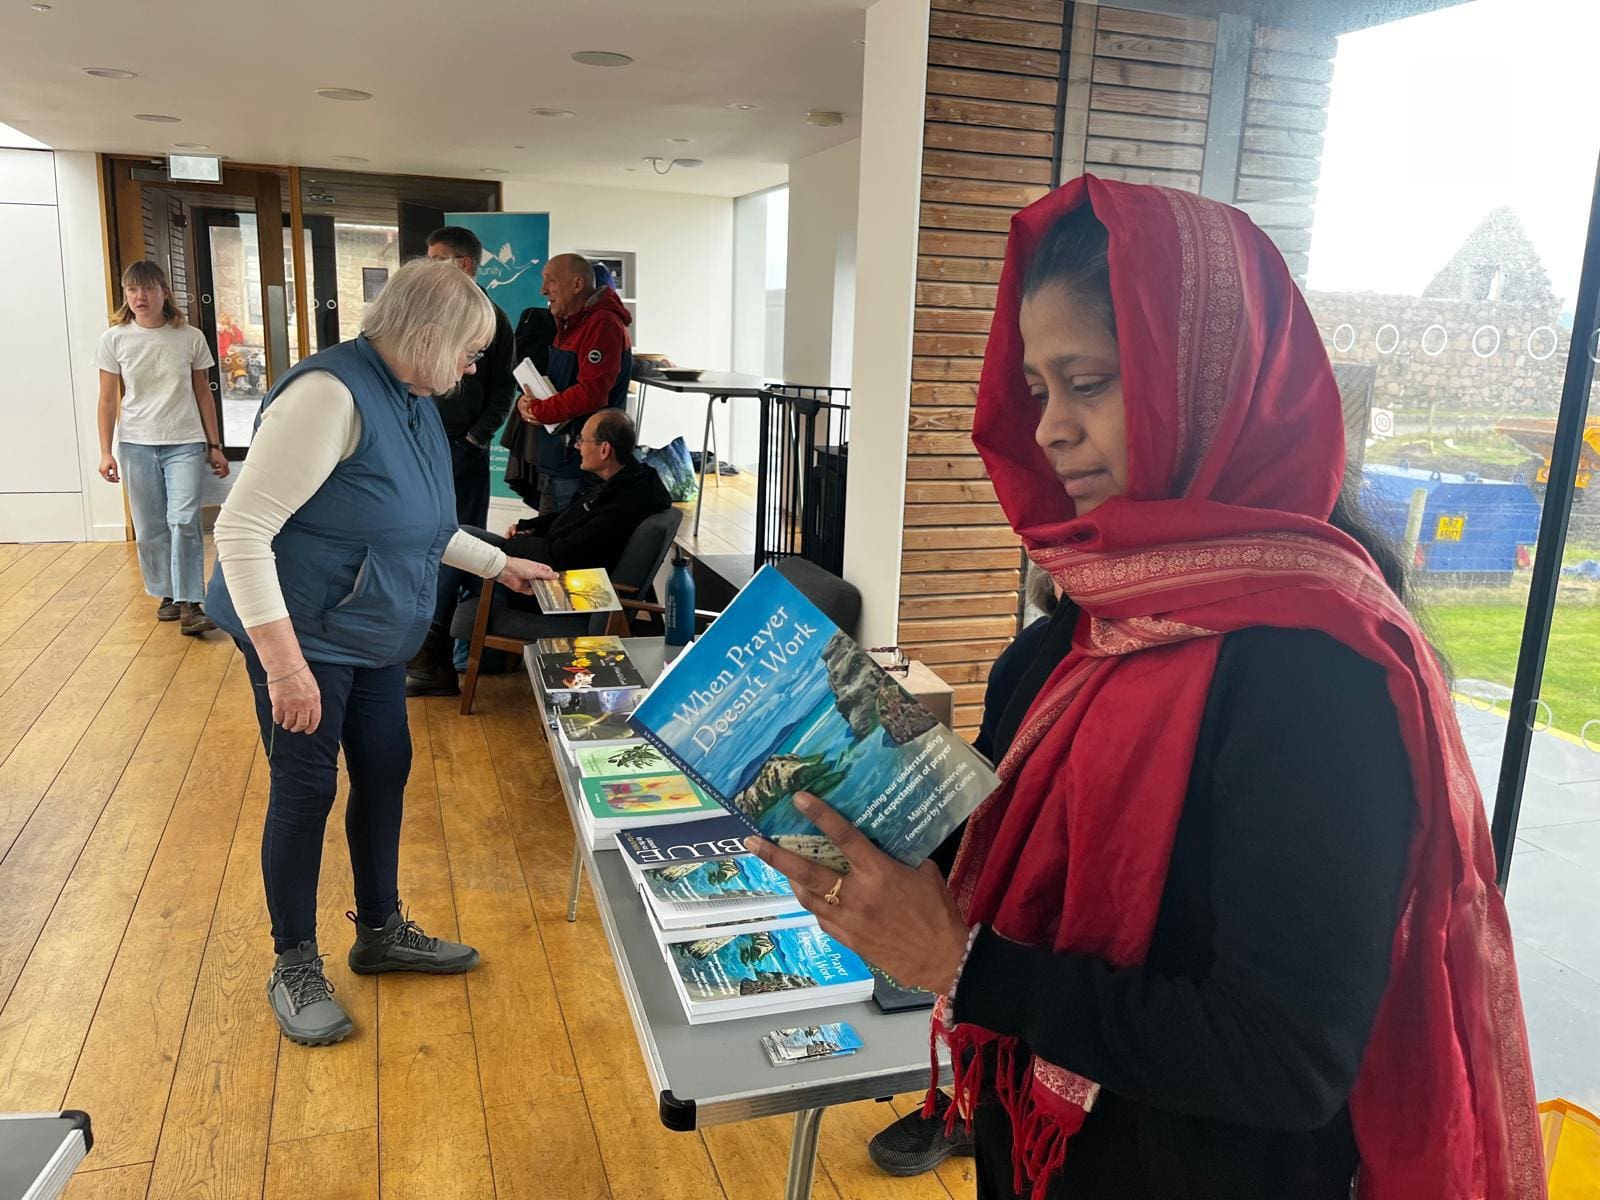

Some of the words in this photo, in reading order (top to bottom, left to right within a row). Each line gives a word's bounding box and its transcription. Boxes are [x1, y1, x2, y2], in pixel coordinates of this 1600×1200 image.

[478, 265, 503, 277] unity
[672, 670, 734, 726] When
[726, 605, 789, 669] Prayer
[692, 675, 769, 757] Doesn't
[759, 622, 817, 674] Work
[643, 730, 671, 755] WHEN
[670, 755, 704, 784] PRAYER
[854, 793, 887, 828] imagining
[884, 780, 898, 795] our
[896, 735, 944, 784] understanding
[870, 813, 885, 829] and
[883, 774, 924, 816] expectations
[922, 764, 932, 776] of
[930, 743, 952, 769] prayer
[905, 813, 933, 842] Foreword
[930, 805, 941, 817] by
[938, 787, 957, 809] Kaitlin
[954, 769, 977, 791] Curtice
[907, 792, 938, 822] Margaret
[934, 762, 968, 794] Somerville
[637, 838, 752, 862] BLUE
[816, 960, 836, 981] Work
[830, 953, 849, 977] Prayer
